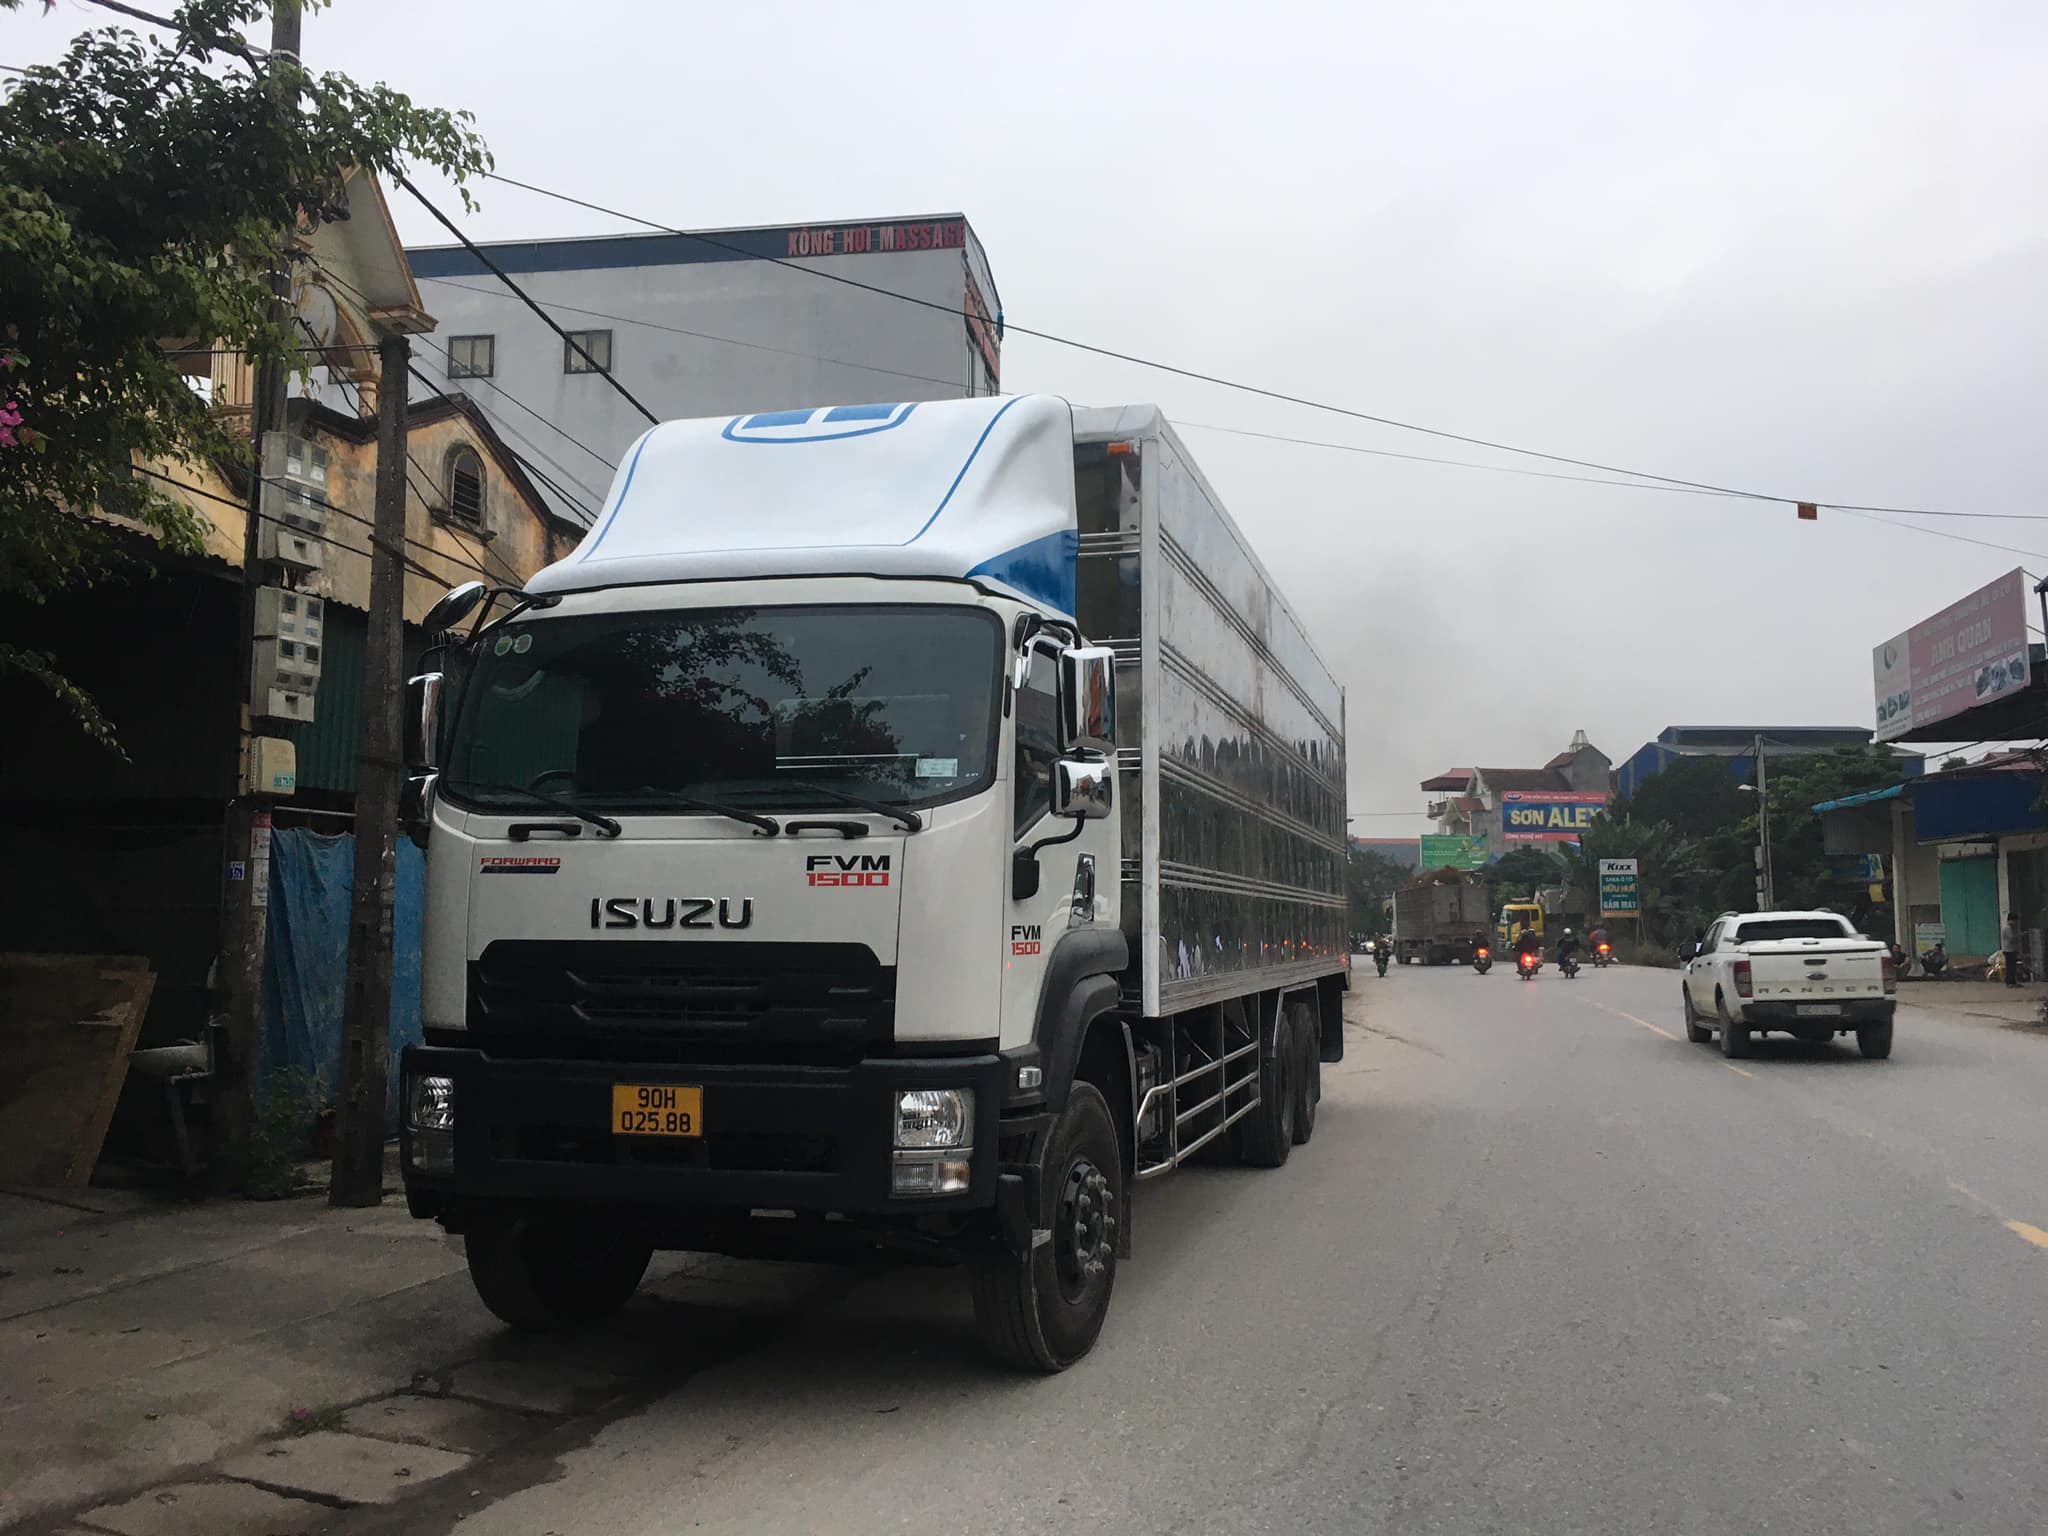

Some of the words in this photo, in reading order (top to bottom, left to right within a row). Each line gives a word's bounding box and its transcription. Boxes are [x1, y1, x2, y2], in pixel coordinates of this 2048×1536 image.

[879, 223, 966, 250] MASSAGE
[1510, 809, 1544, 825] SƠN
[480, 857, 561, 865] FORWARD
[806, 855, 891, 872] FVM
[806, 873, 890, 887] 1500
[591, 897, 754, 929] ISUZU
[1011, 925, 1041, 940] FVM
[1011, 942, 1041, 956] 1500
[637, 1088, 676, 1110] 90H
[621, 1112, 691, 1133] 025.88
